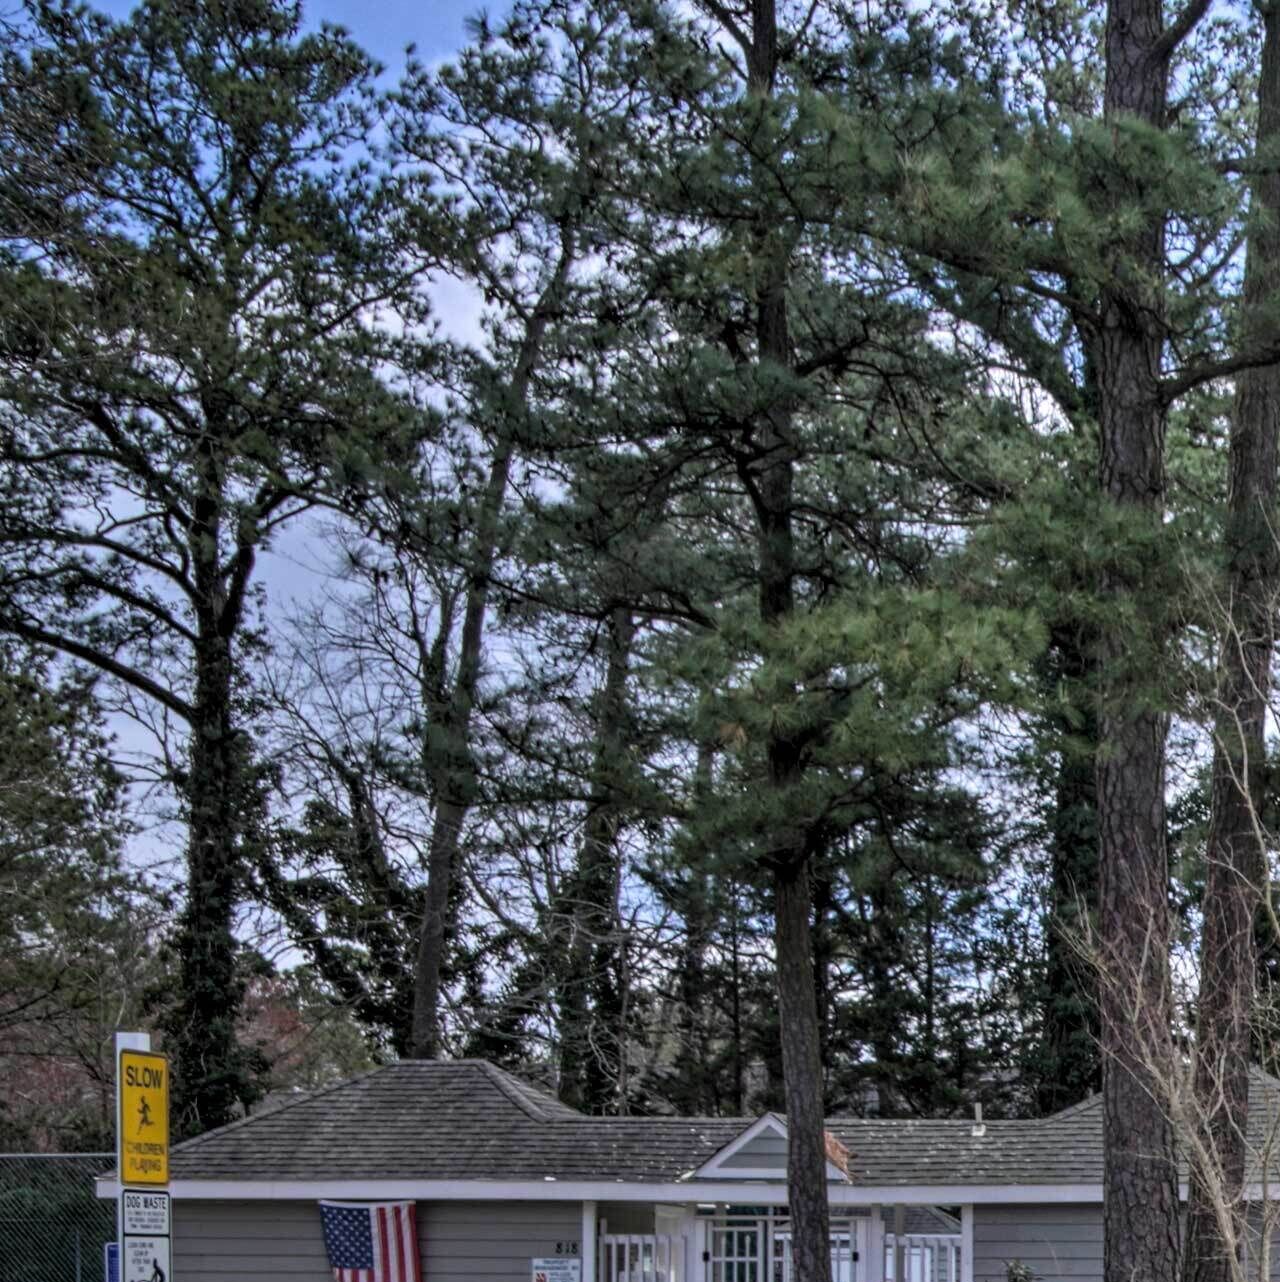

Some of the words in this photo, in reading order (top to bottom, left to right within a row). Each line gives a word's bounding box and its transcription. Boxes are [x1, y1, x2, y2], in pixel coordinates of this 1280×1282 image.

[126, 1065, 163, 1088] SLOW
[127, 1195, 141, 1208] DOG
[143, 1196, 166, 1209] WASTE
